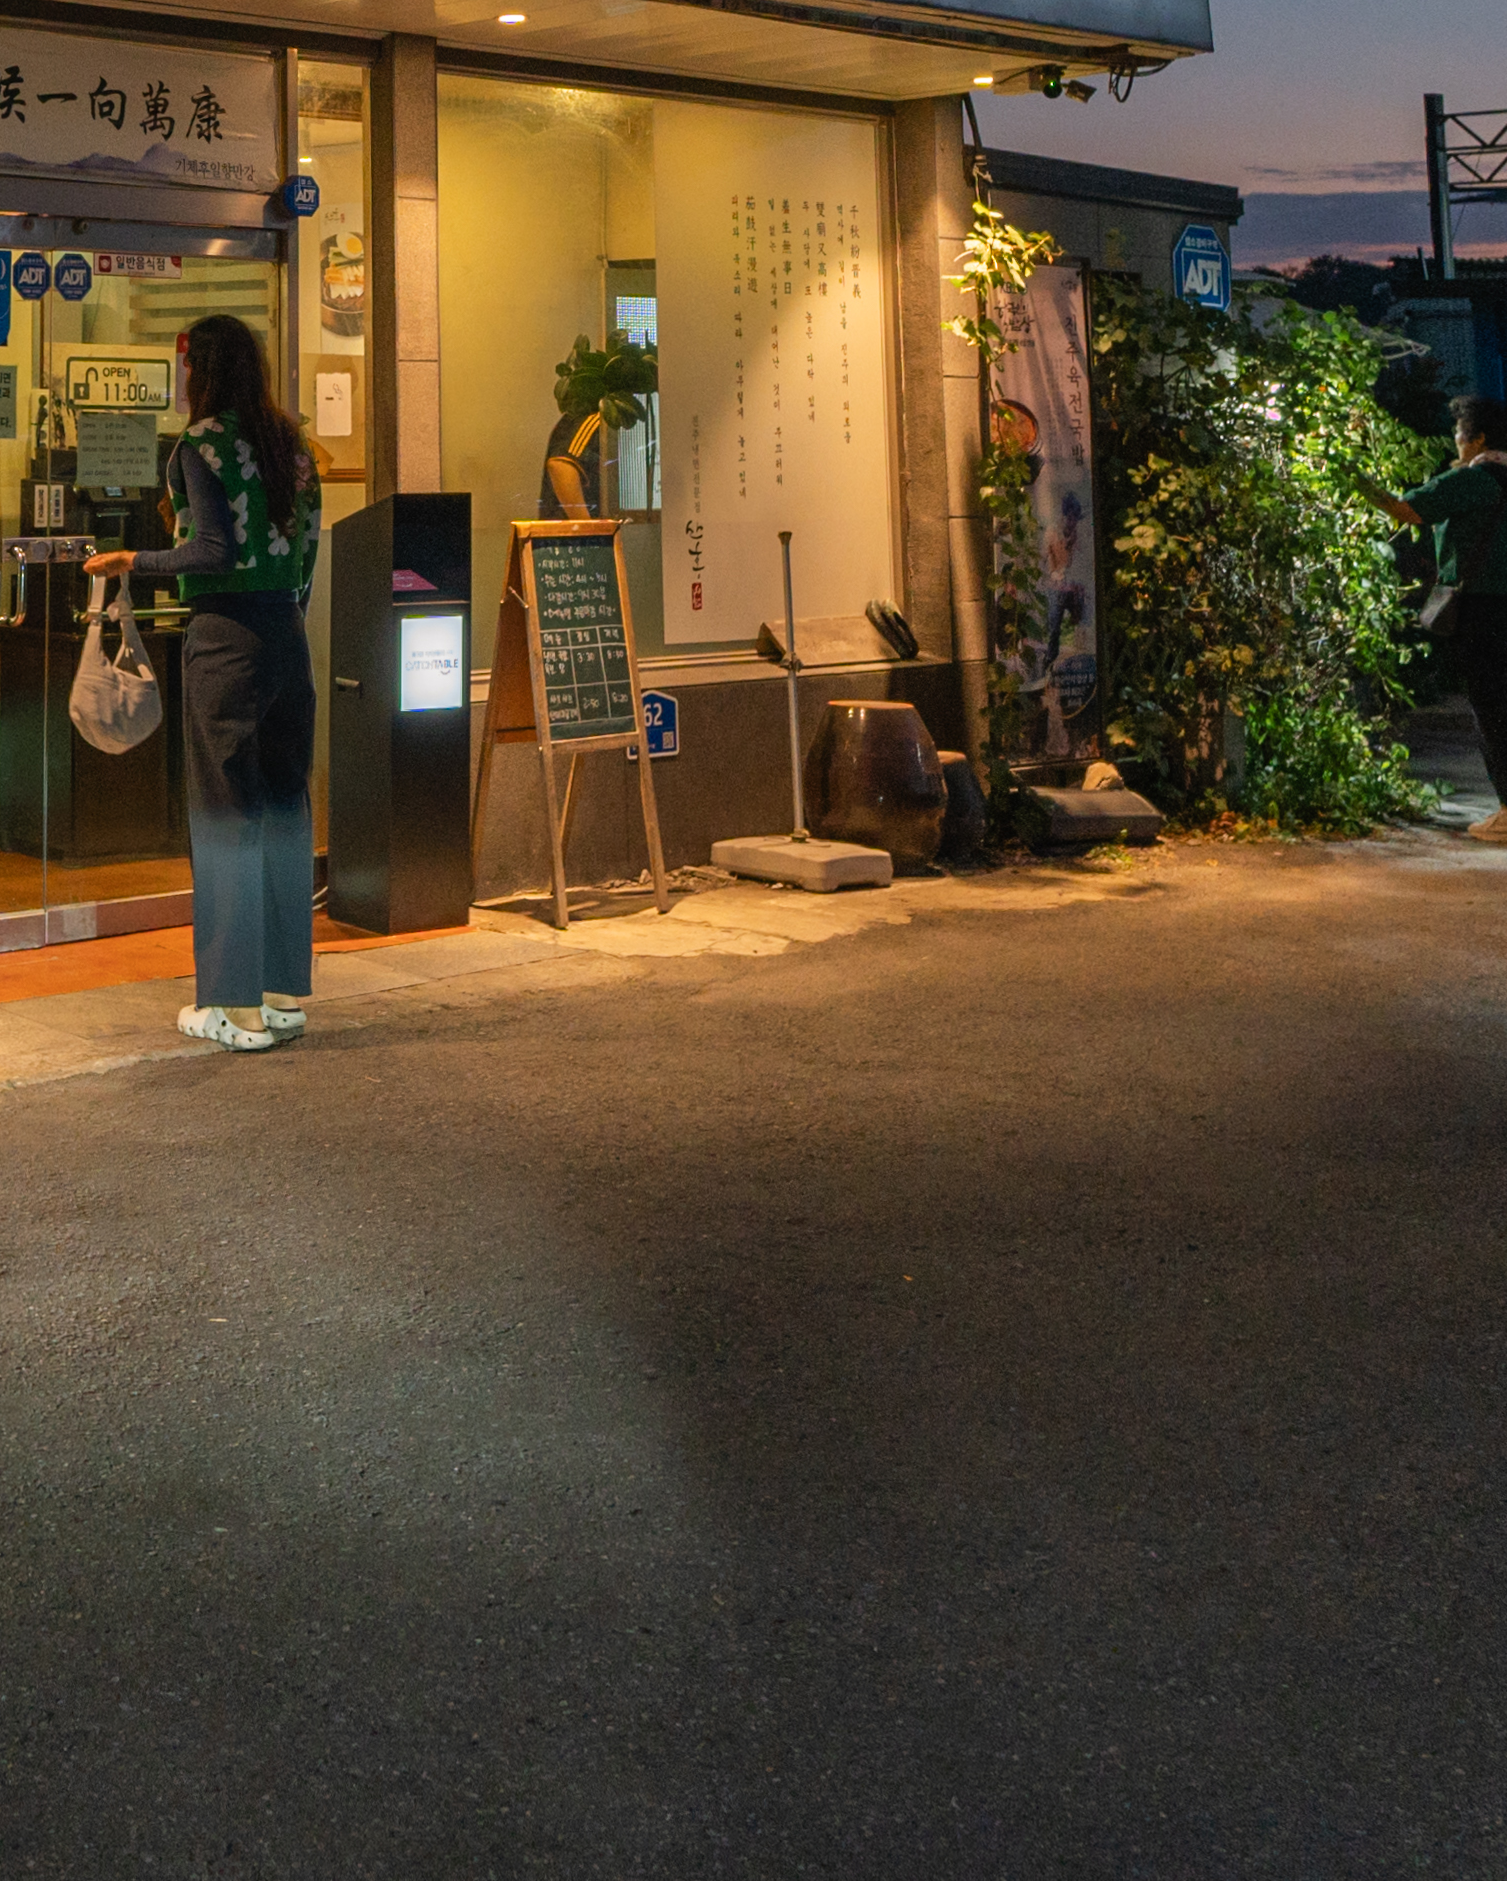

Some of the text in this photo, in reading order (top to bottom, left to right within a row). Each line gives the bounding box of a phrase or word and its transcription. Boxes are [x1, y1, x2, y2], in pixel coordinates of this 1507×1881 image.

[295, 189, 316, 203] ADT
[116, 255, 166, 271] 일반음식점
[18, 267, 45, 285] ADT
[60, 269, 87, 286] ADT
[1183, 259, 1222, 296] ADT
[102, 367, 131, 378] OPEN
[1065, 314, 1085, 467] 진주육전국밥
